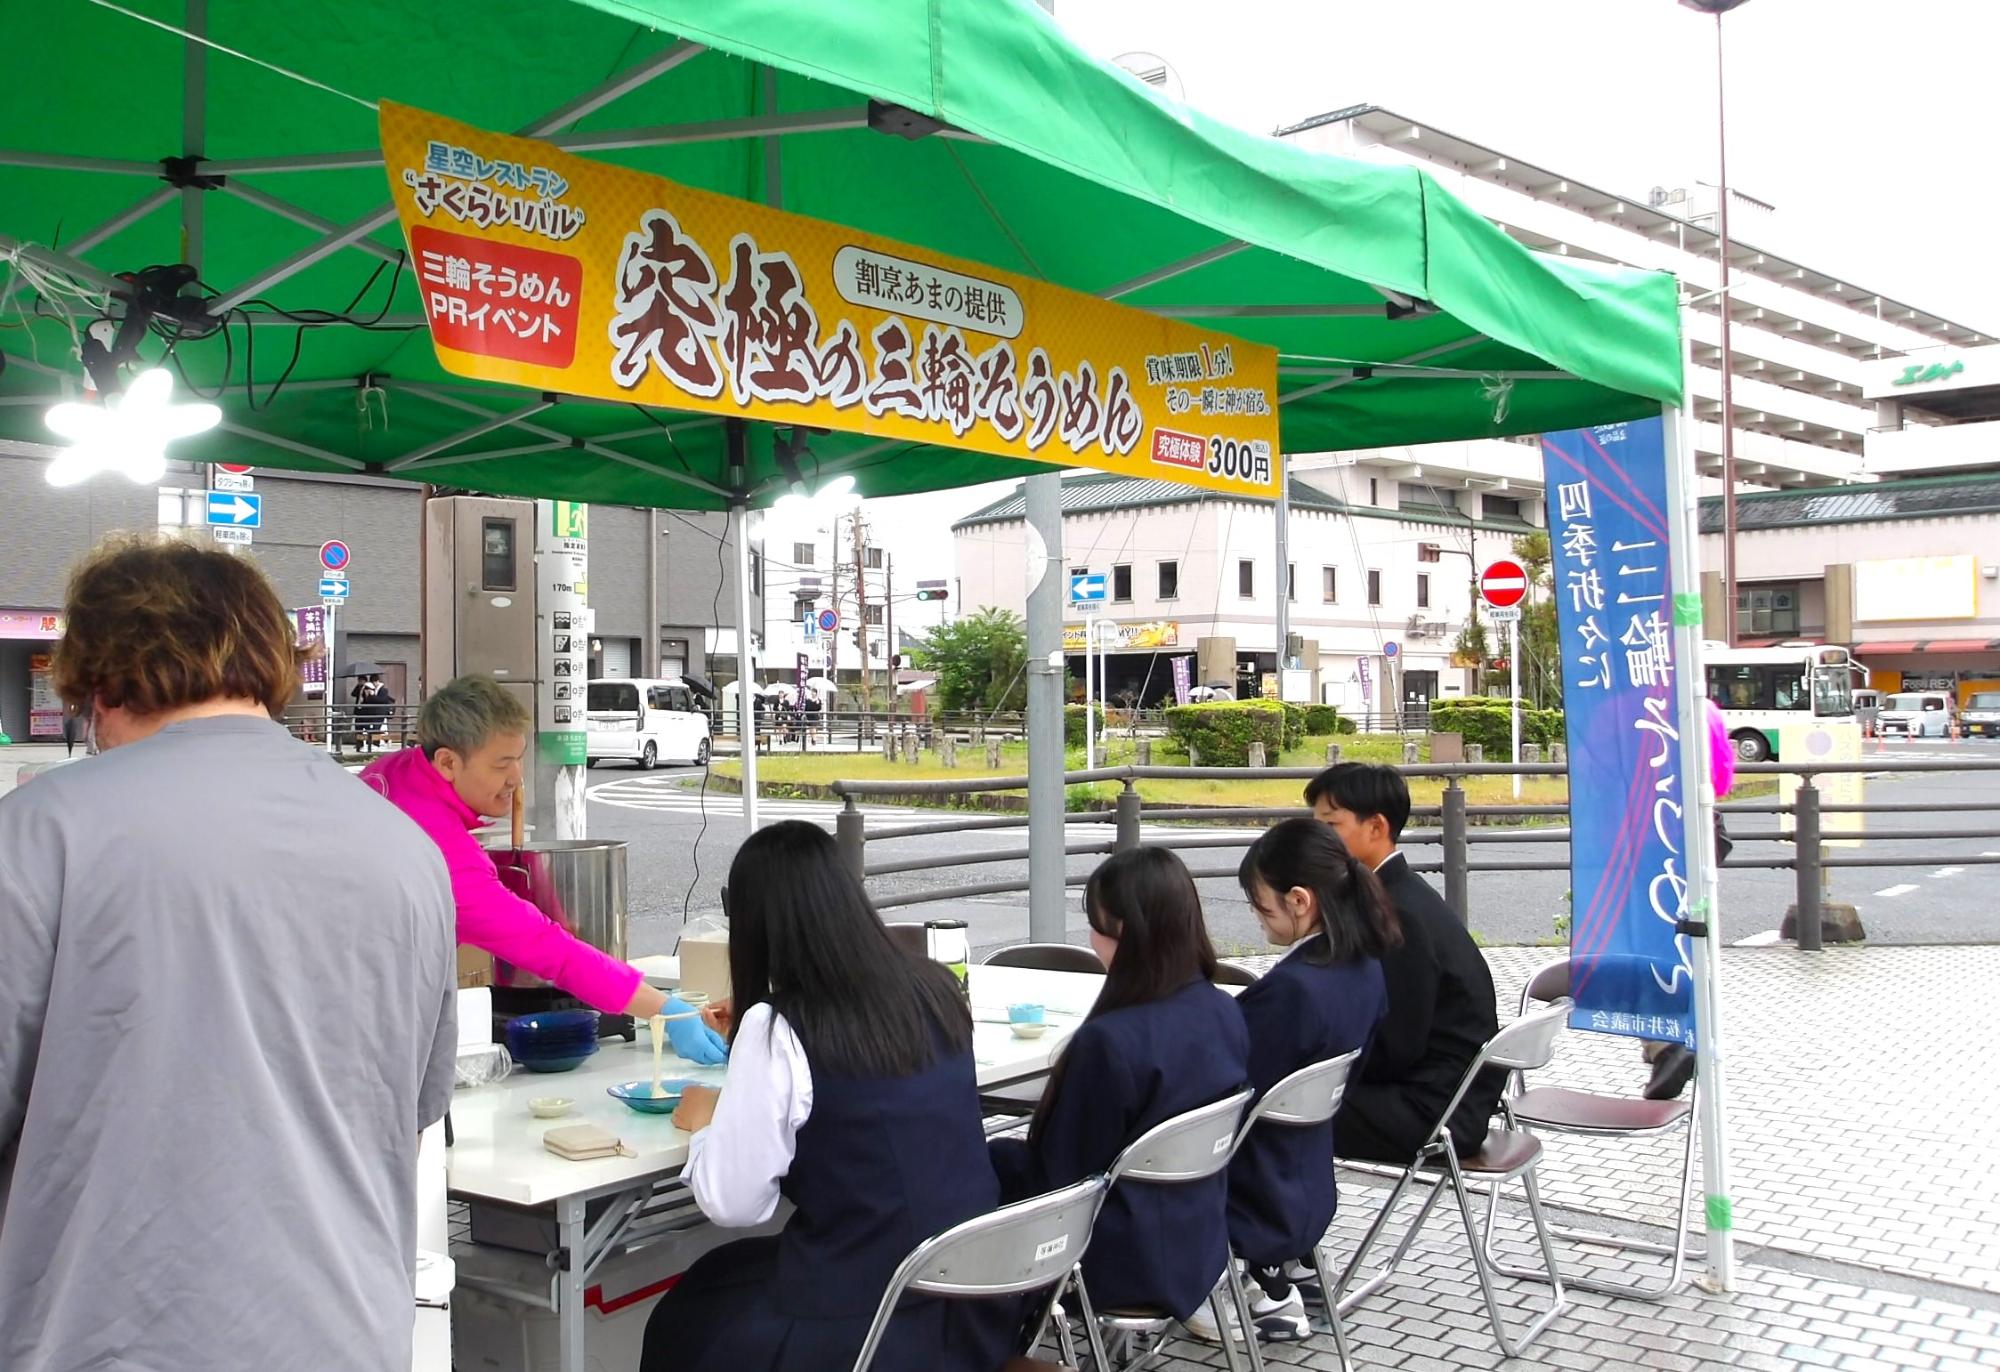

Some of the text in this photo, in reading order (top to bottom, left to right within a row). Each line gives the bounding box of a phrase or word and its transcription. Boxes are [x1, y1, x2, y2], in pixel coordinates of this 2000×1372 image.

[426, 141, 568, 199] 星空レストラン
[422, 249, 571, 308] 三輪そうめん
[855, 258, 1007, 327] 割烹あまの提供
[430, 292, 562, 344] PRイベント
[611, 211, 1140, 452] 究極の三輪そうめん
[1157, 435, 1202, 463] 究極体験
[1208, 437, 1270, 482] 300円
[552, 583, 572, 592] 170m
